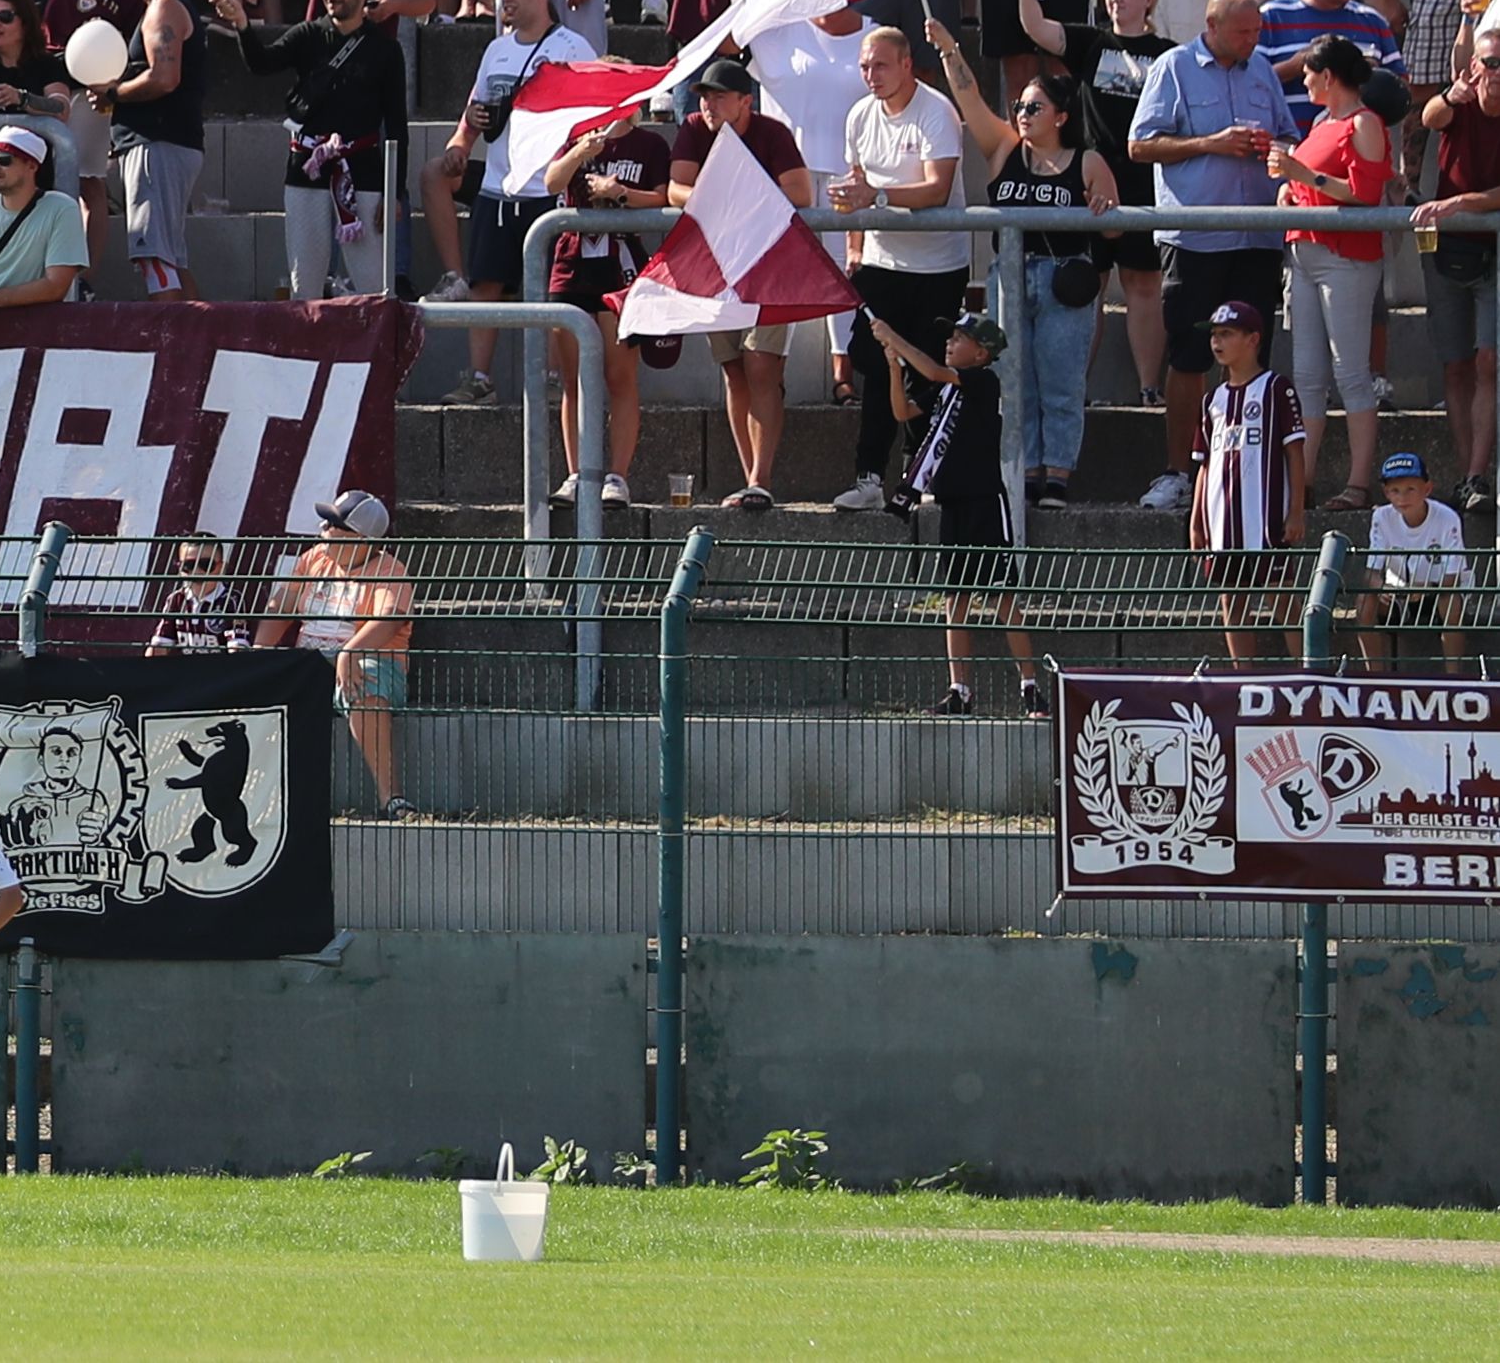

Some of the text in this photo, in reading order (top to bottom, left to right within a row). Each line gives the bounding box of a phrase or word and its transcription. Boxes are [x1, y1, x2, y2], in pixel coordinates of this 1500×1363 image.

[176, 630, 219, 647] DWB
[1238, 683, 1490, 722] DYNAMO
[1372, 812, 1500, 828] DER GEILSTE CL
[1115, 840, 1194, 866] 1954
[1383, 852, 1500, 888] BER
[21, 891, 101, 911] iefkes
